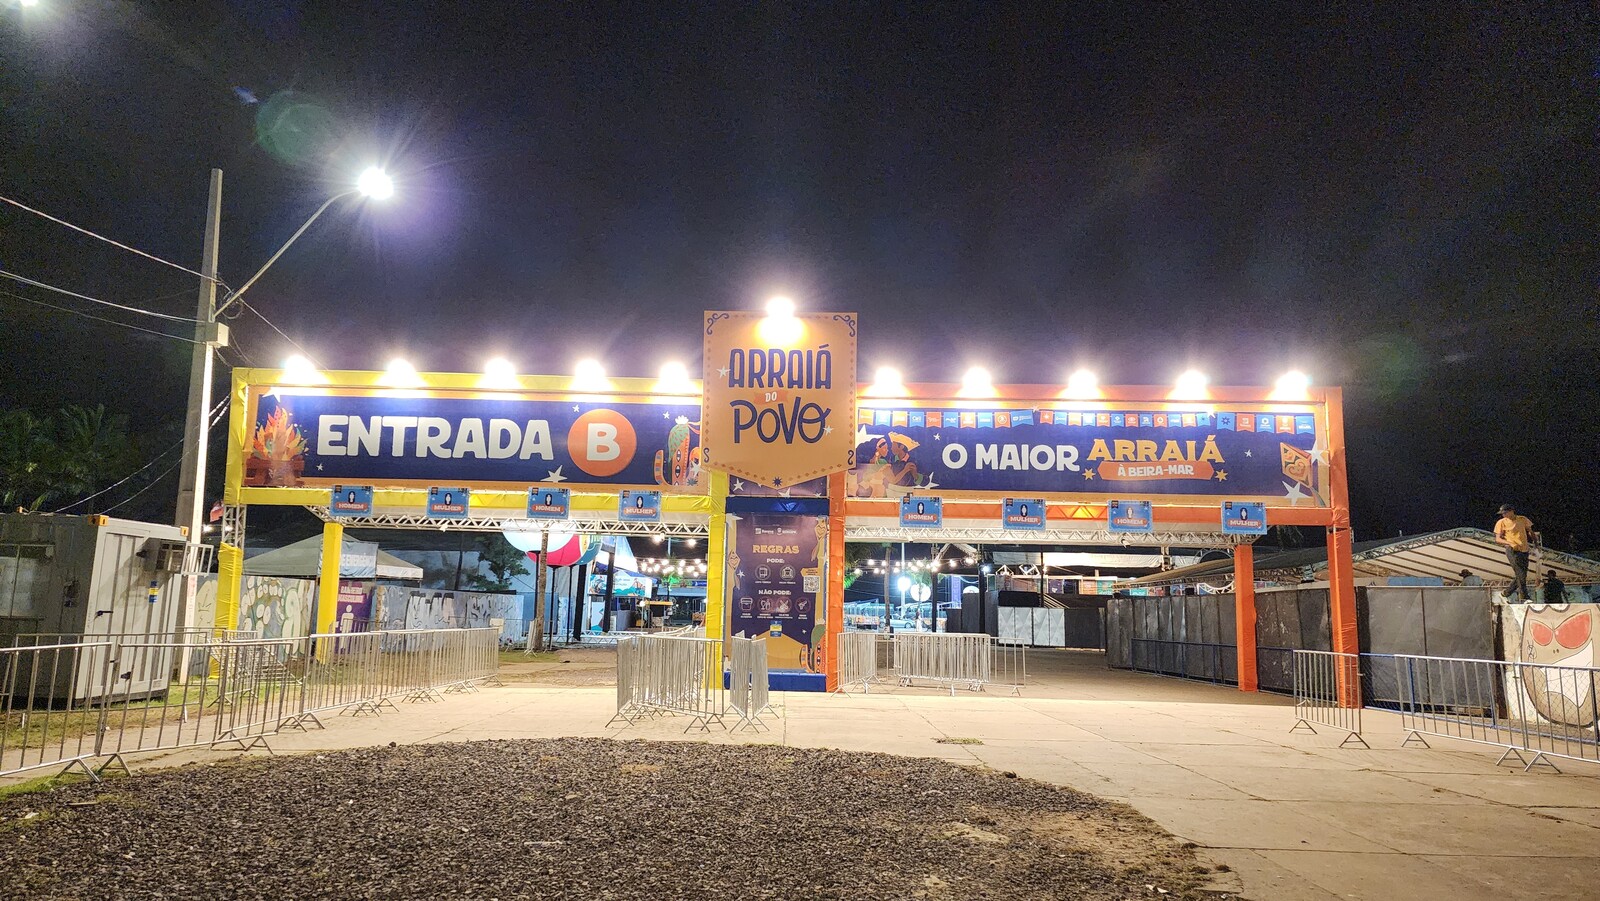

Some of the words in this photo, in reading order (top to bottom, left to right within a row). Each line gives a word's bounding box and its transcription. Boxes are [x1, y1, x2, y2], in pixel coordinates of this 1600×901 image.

[728, 344, 832, 389] ARRAIÁ
[765, 391, 778, 403] DO
[729, 396, 832, 444] POVO
[317, 414, 554, 461] ENTRADA
[586, 422, 621, 462] B
[1087, 434, 1225, 463] ARRAIÁ
[941, 443, 968, 470] O
[975, 443, 1080, 472] MAIOR
[1117, 463, 1126, 477] À
[1128, 464, 1195, 477] BEIRA-MAR
[433, 503, 462, 511] MULHER
[625, 507, 654, 515] MULHER
[1009, 515, 1039, 523] MULHER
[1229, 519, 1259, 527] MULHER
[752, 544, 800, 554] REGRAS
